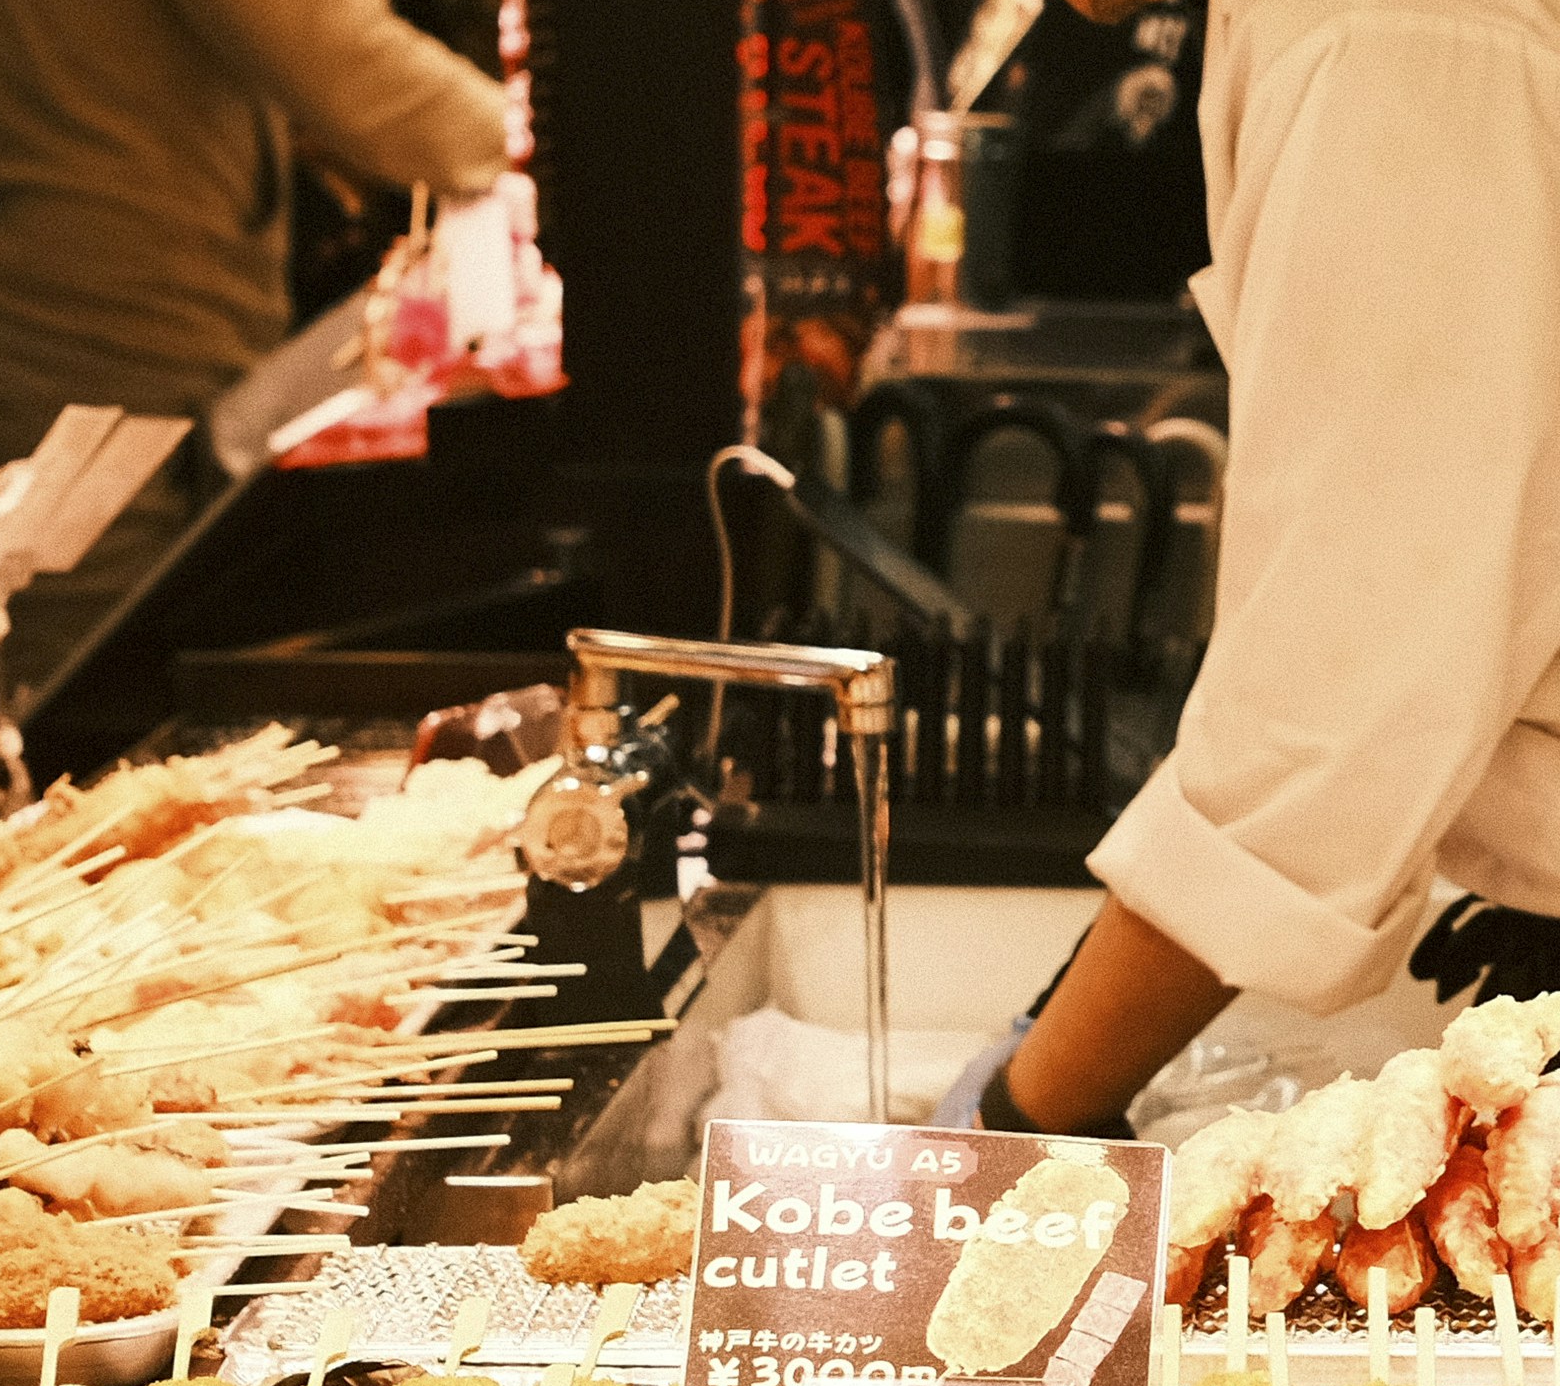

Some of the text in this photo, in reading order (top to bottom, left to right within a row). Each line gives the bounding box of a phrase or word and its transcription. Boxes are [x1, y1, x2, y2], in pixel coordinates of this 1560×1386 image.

[777, 35, 843, 257] STEAK
[748, 1142, 963, 1176] WAGYU A5
[711, 1179, 1118, 1250] Kobe beef
[702, 1244, 898, 1293] cutlet
[697, 1328, 884, 1355] 神戸牛の牛カツ
